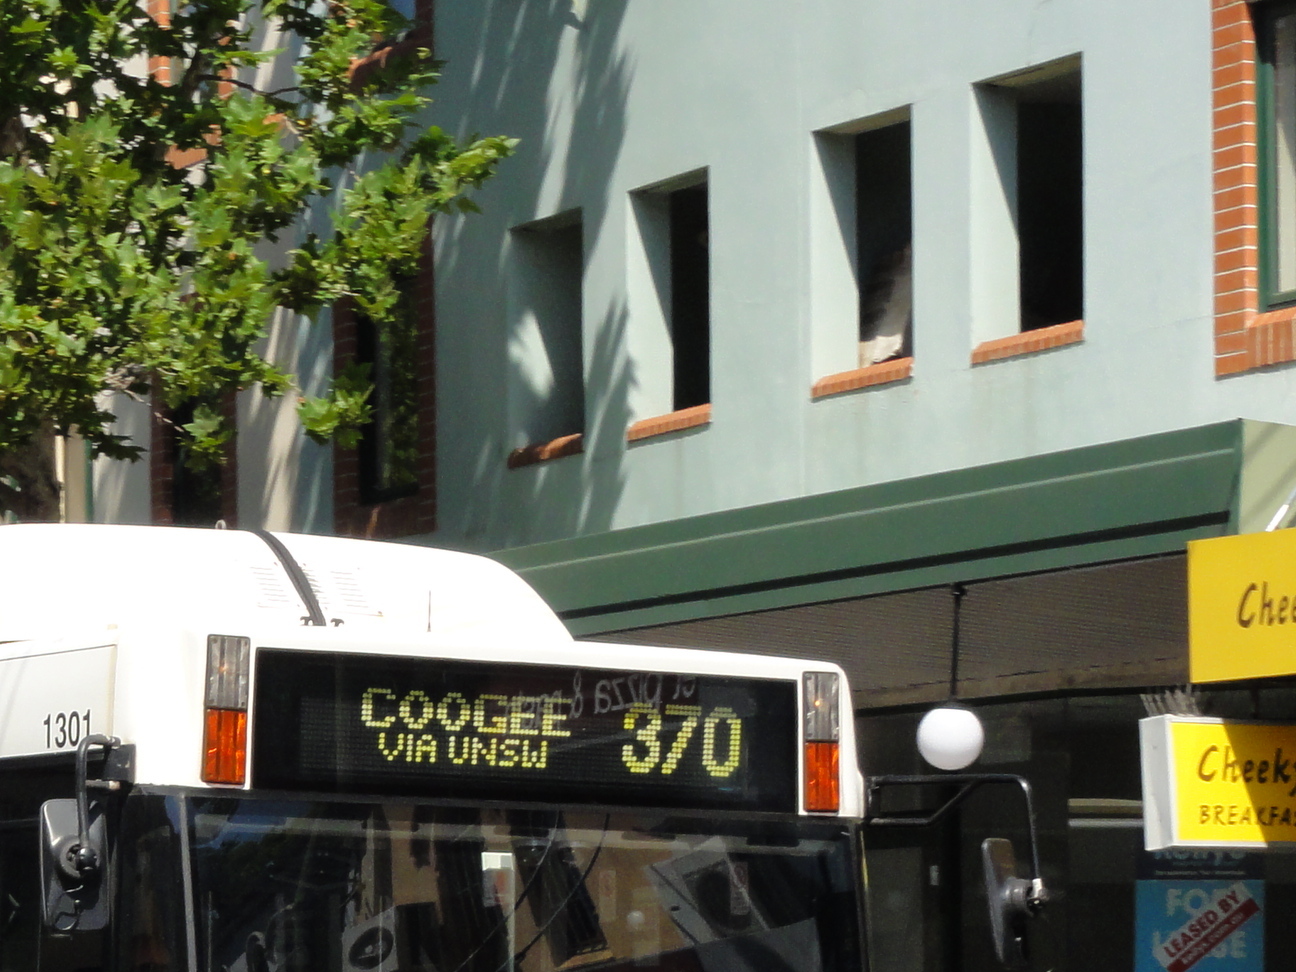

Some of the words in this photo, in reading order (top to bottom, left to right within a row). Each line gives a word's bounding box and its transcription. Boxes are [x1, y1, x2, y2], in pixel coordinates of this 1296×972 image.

[43, 708, 91, 749] 1301
[361, 687, 571, 737] COOGEE
[622, 702, 742, 777] 370
[379, 732, 437, 764] VIA
[448, 735, 548, 769] UNSW
[1199, 804, 1296, 827] BREAKFA
[1164, 910, 1219, 957] LEASED
[1218, 890, 1241, 913] BY
